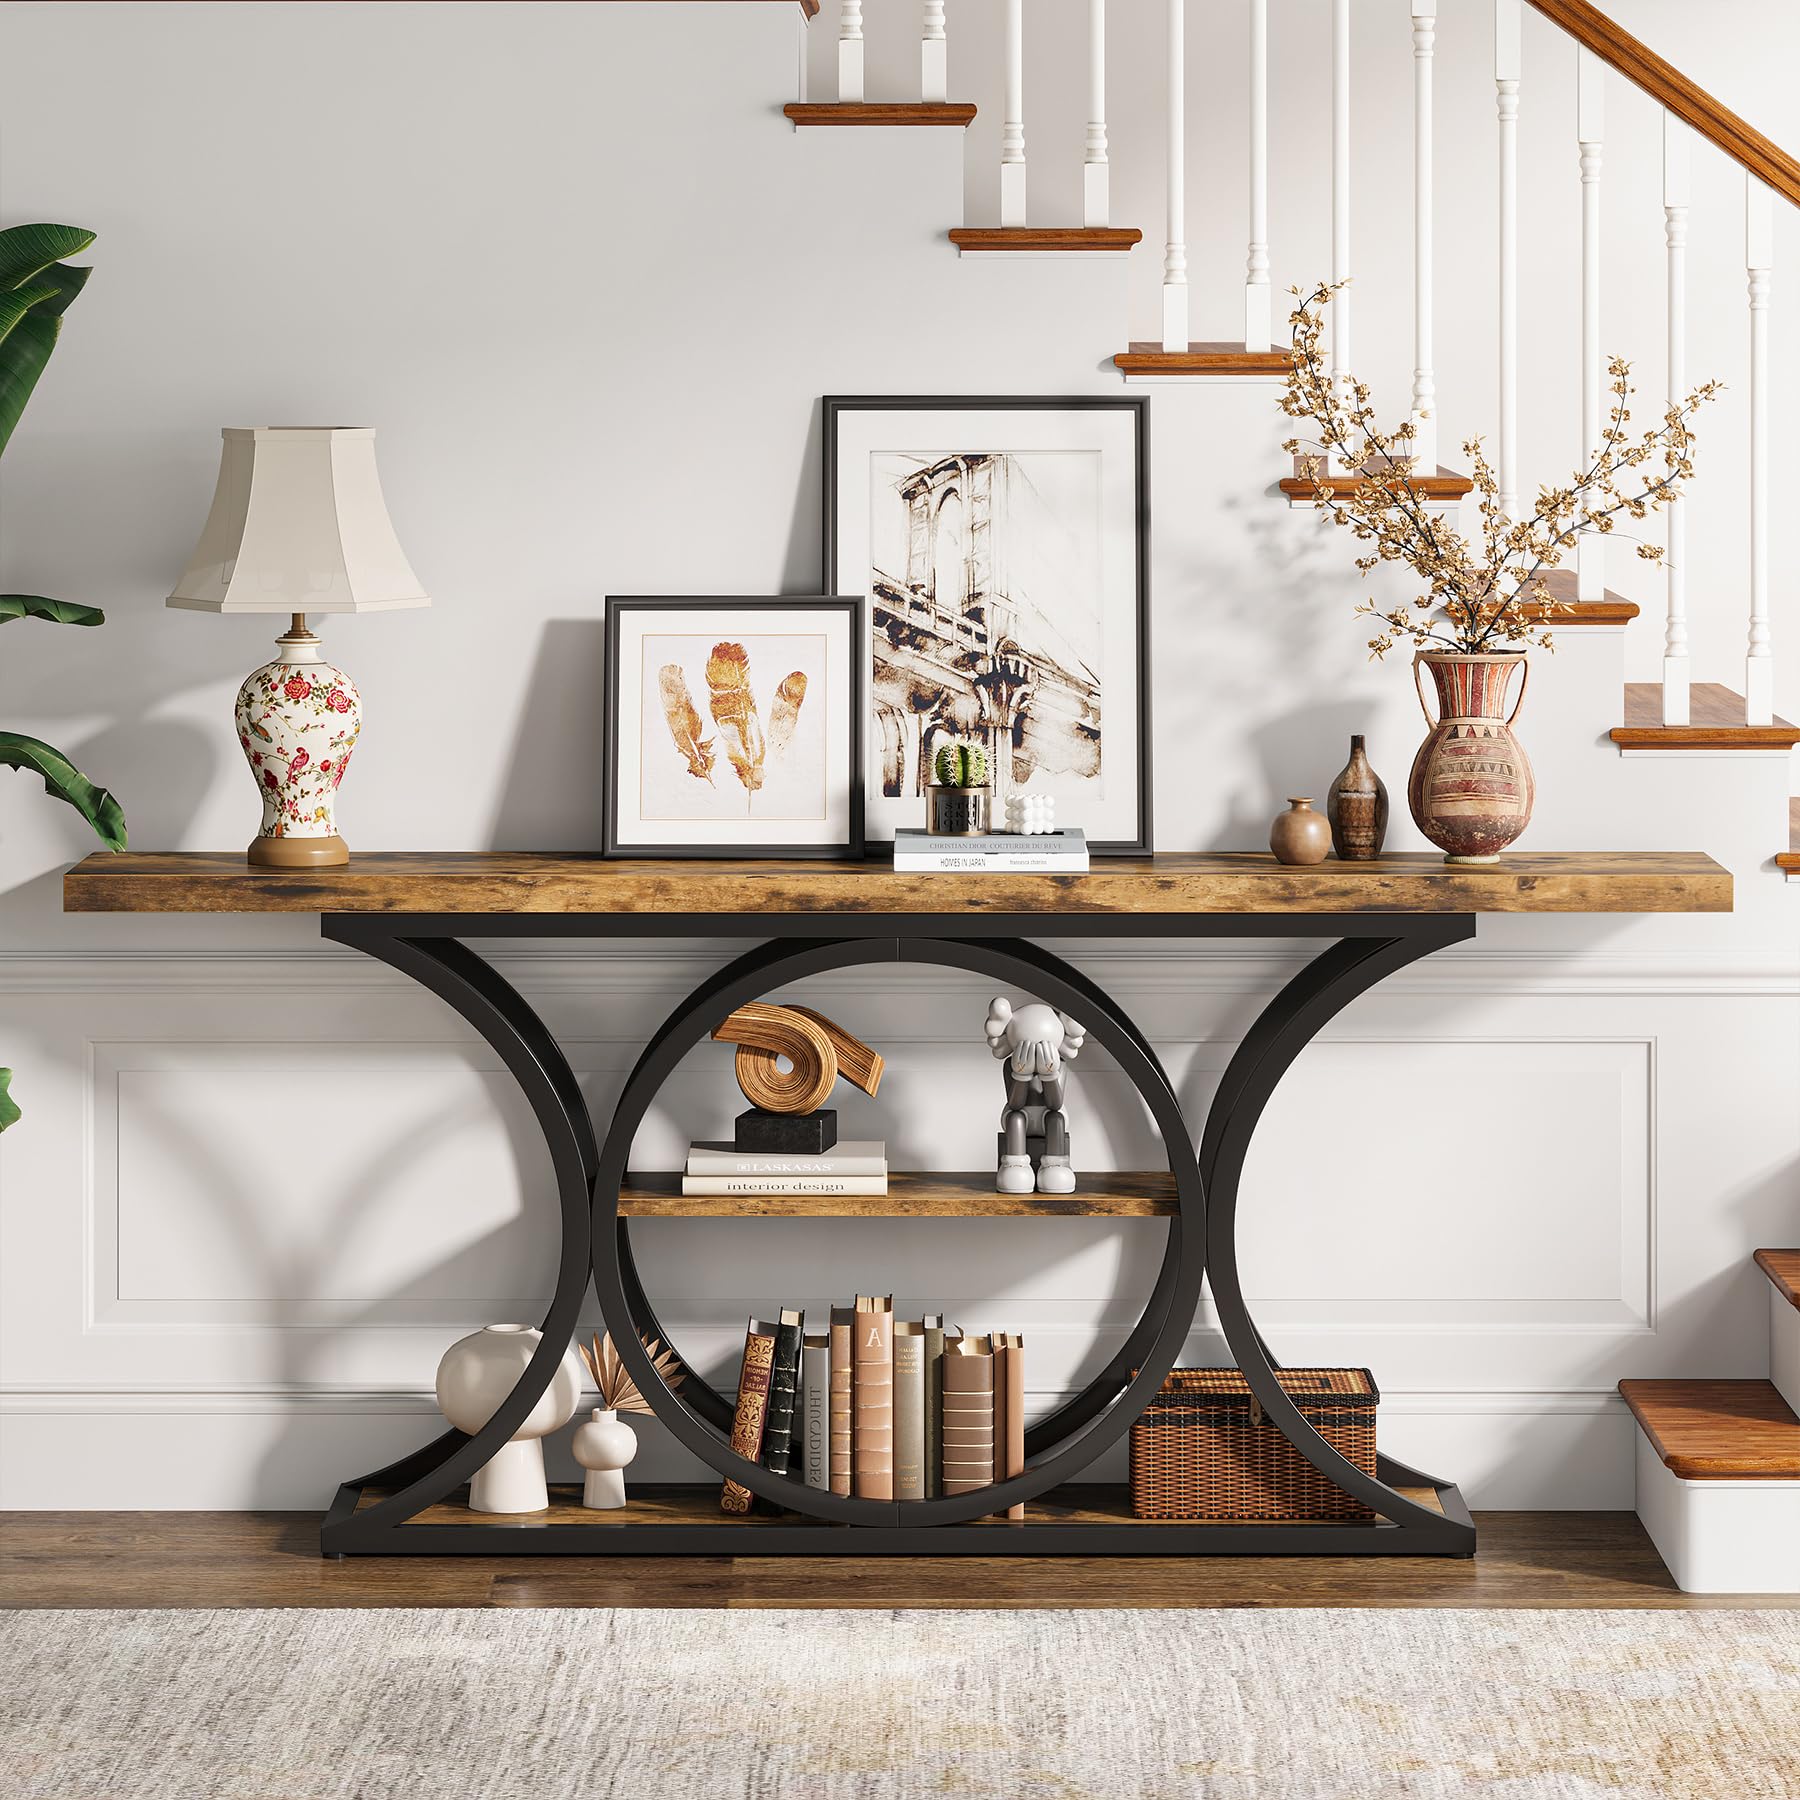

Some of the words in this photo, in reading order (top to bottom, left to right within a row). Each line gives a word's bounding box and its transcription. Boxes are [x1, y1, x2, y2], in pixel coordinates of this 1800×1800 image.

[940, 857, 961, 868] HOMES
[961, 857, 968, 868] IN
[969, 857, 986, 868] JAPAN
[727, 1181, 789, 1191] interior
[792, 1181, 845, 1192] design
[864, 1327, 884, 1348] A
